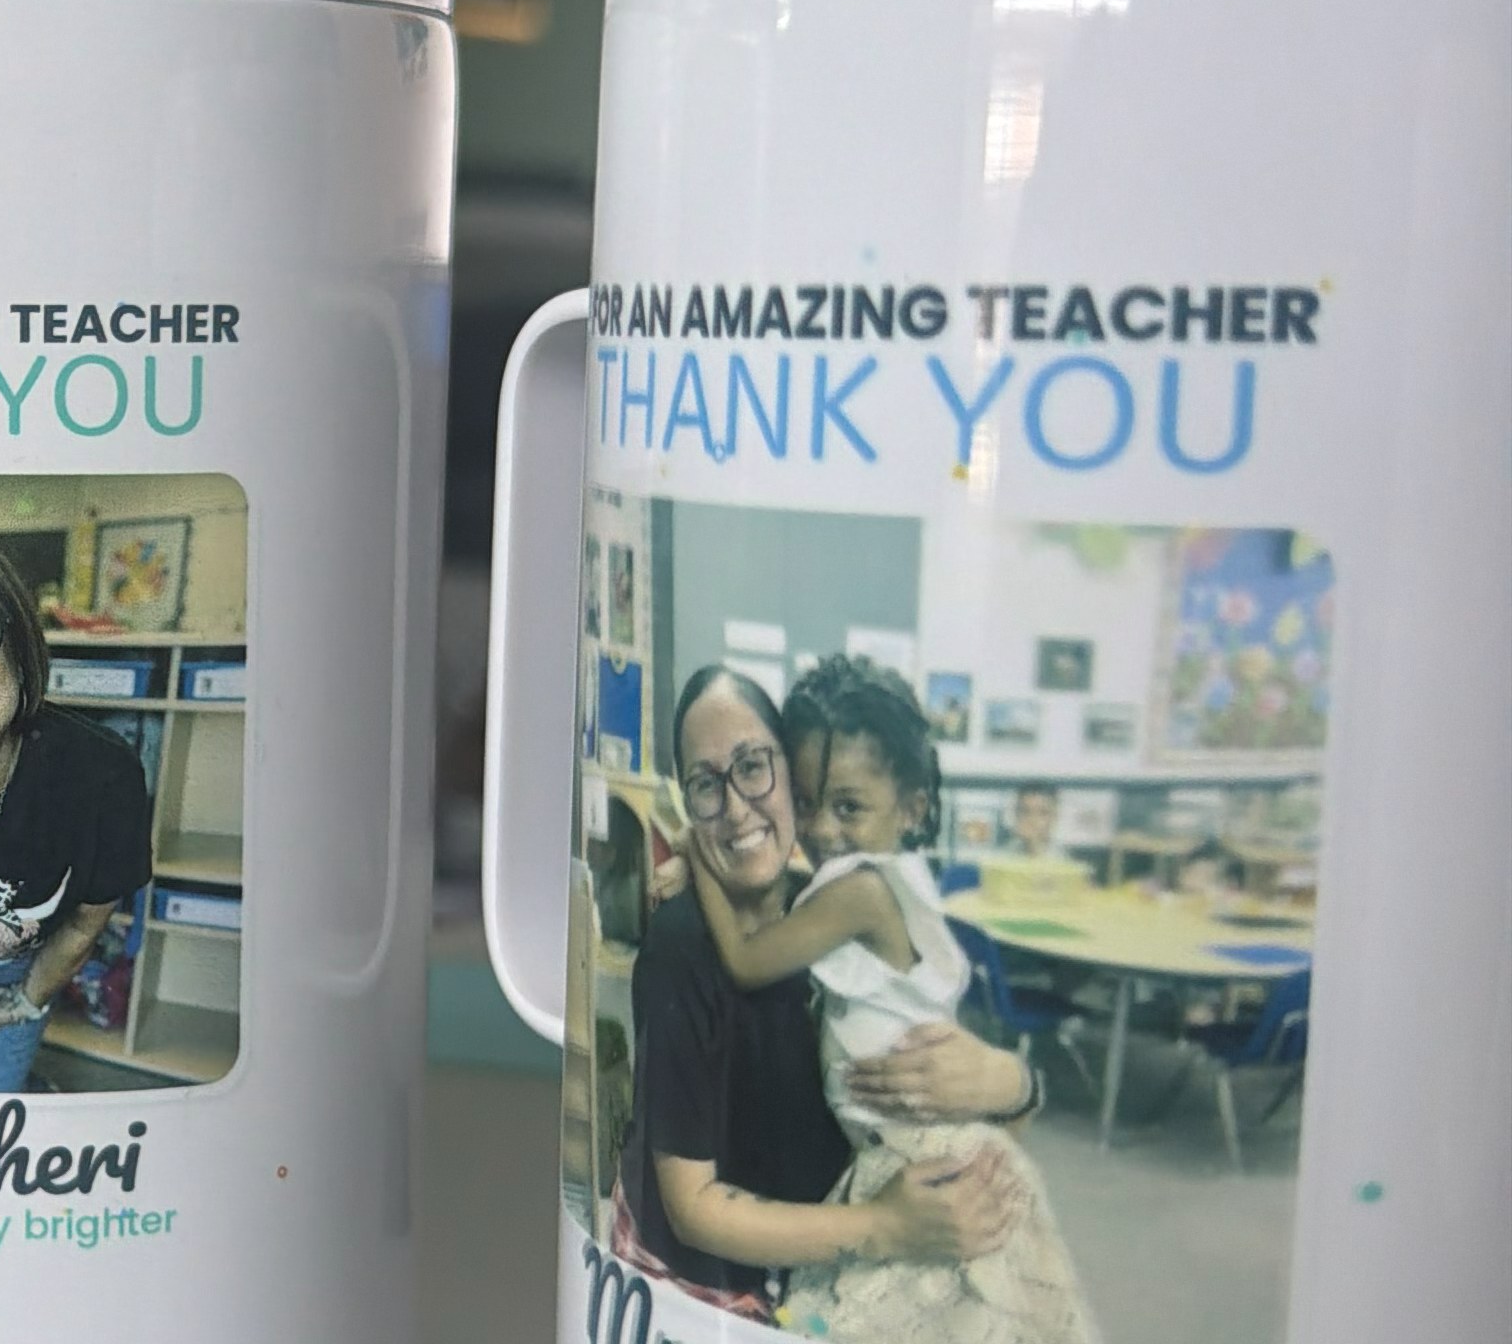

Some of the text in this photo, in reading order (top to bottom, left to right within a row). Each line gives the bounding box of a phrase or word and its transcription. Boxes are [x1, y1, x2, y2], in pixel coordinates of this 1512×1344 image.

[10, 303, 240, 344] TEACHER
[589, 282, 1321, 344] FOR AN AMAZING TEACHER
[597, 347, 1256, 474] THANK YOU
[25, 1204, 177, 1248] brighter
